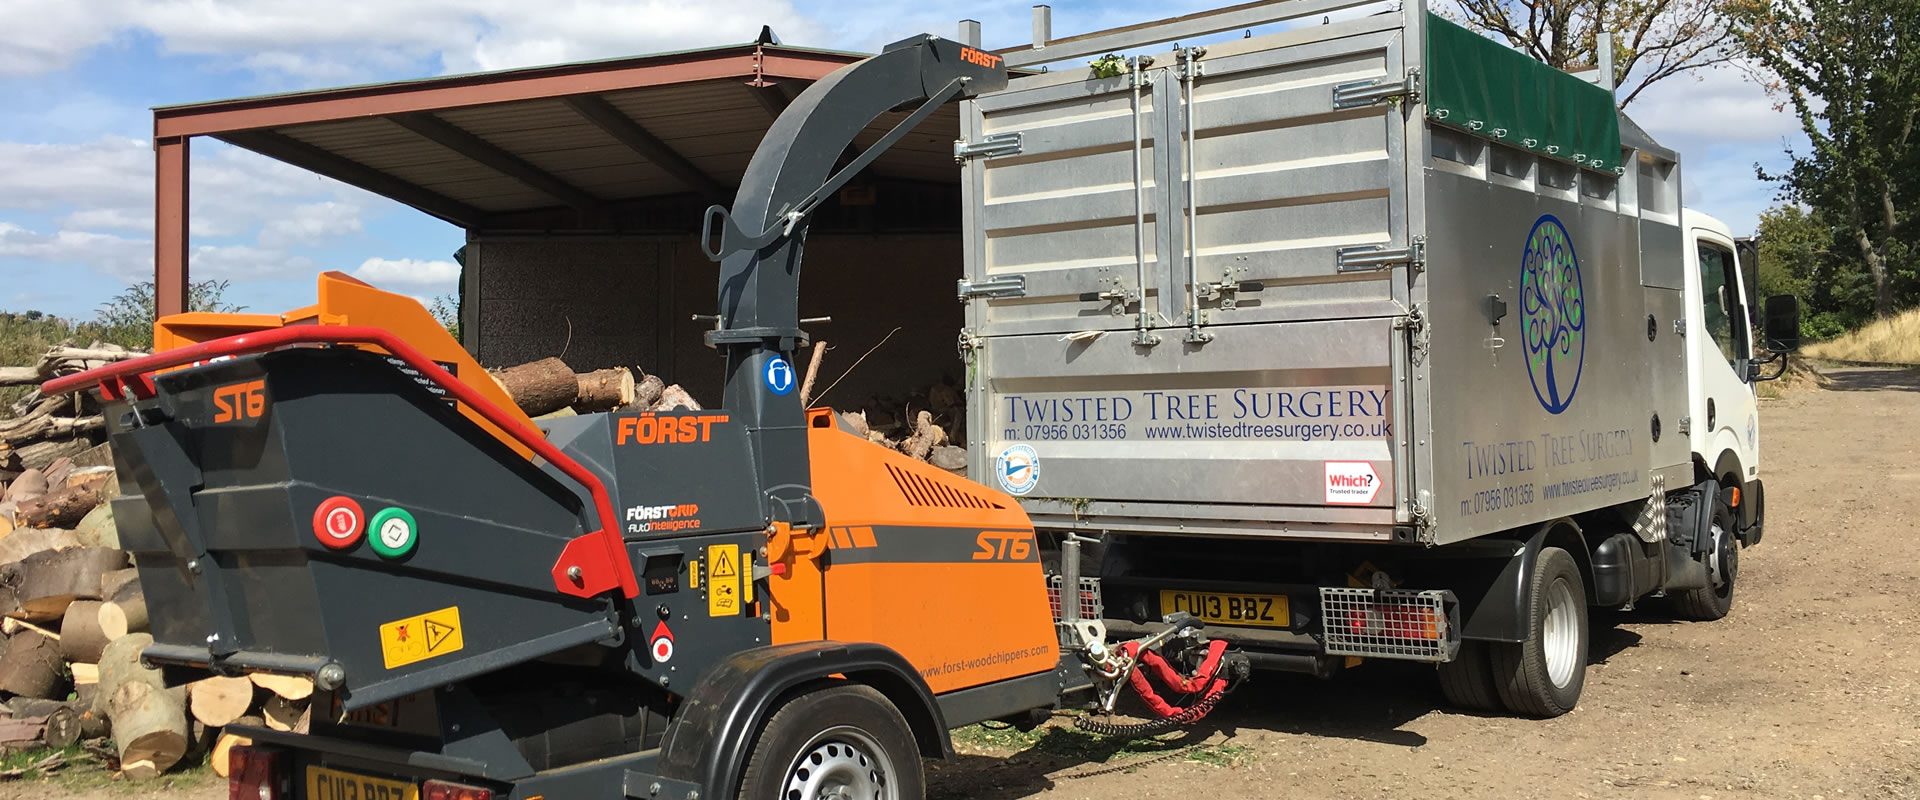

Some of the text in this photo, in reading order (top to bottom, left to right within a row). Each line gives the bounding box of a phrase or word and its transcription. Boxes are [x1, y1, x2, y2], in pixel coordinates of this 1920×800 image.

[960, 46, 1003, 70] FÖRST
[213, 379, 265, 424] ST6
[1004, 389, 1391, 423] TWISTED TREE SURGERY
[616, 412, 729, 445] FÖRST
[1004, 419, 1393, 442] m: 07956 031356 www.twistedtreesurgery.co.uk
[1329, 473, 1374, 487] Which?
[1460, 498, 1472, 516] m:
[1474, 488, 1502, 514] 07956
[1503, 483, 1534, 508] 031356
[972, 530, 1034, 560] ST6
[1174, 593, 1275, 622] CU13 BBZ
[919, 644, 1048, 677] www.forst-woodchippers.com
